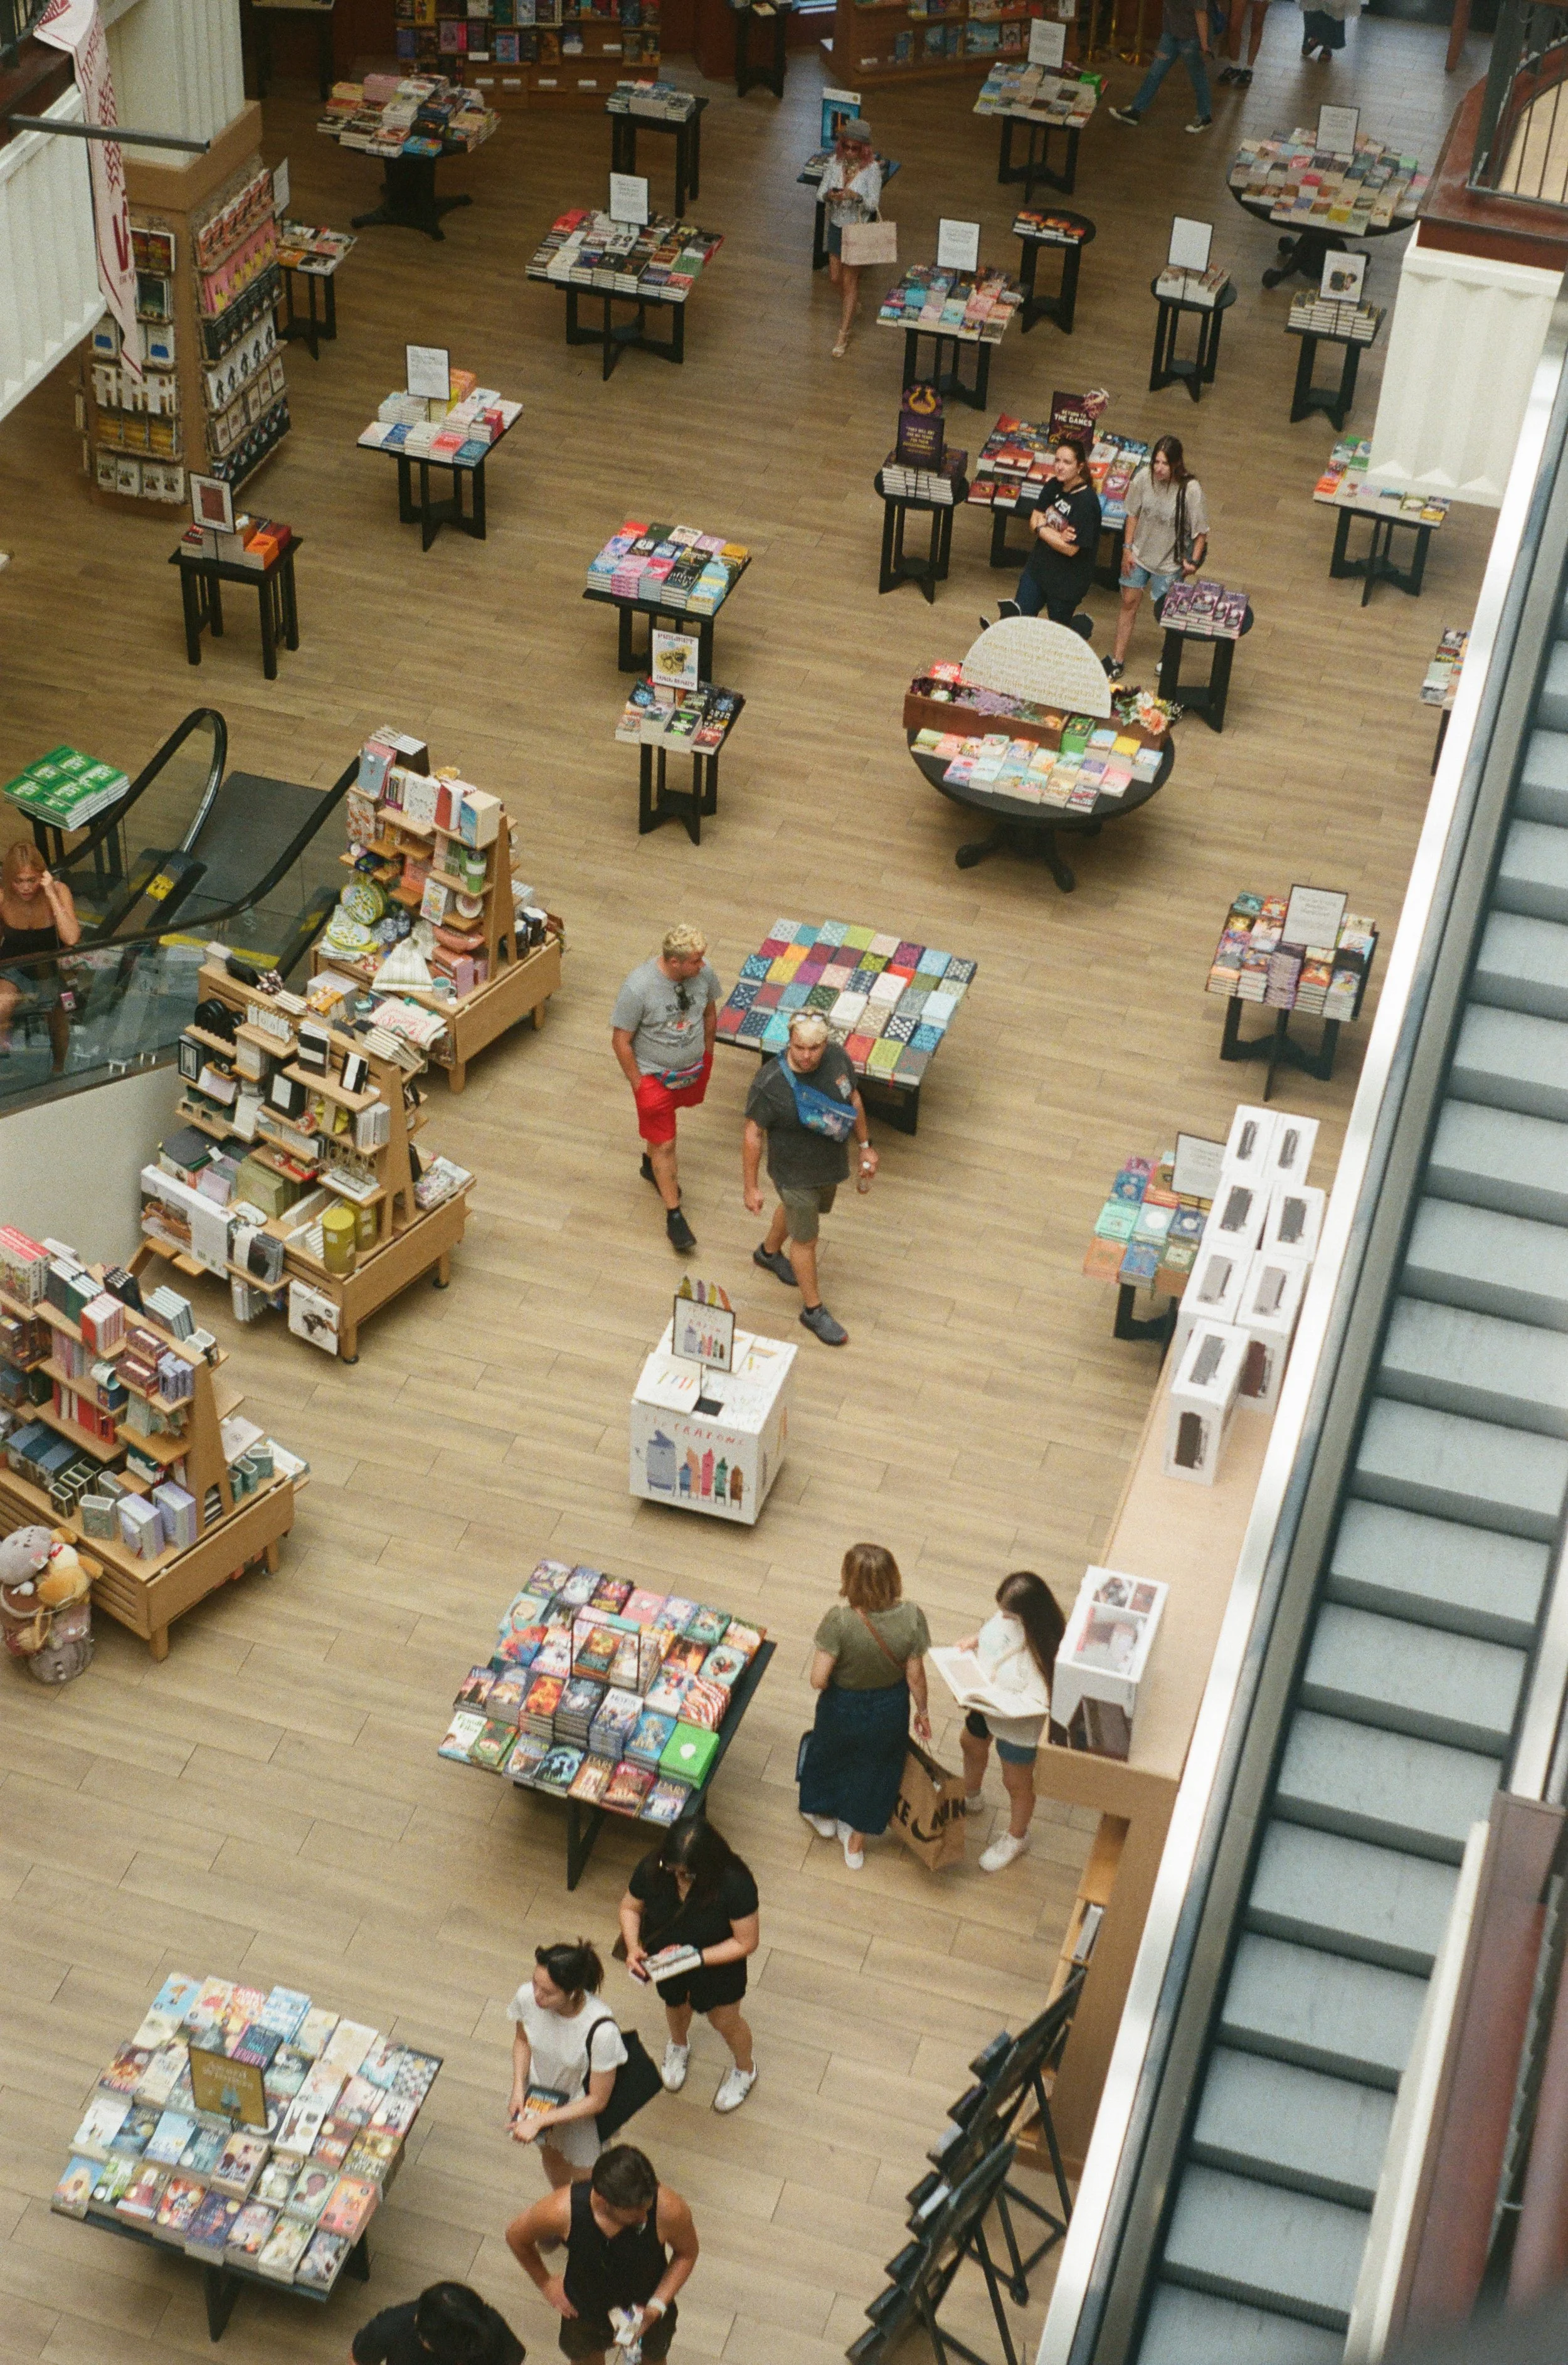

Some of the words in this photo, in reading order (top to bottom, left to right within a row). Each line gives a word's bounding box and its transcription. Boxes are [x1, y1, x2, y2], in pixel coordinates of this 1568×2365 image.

[1054, 413, 1067, 422] THE
[1068, 416, 1092, 427] GAMES
[658, 1780, 686, 1796] LIARS
